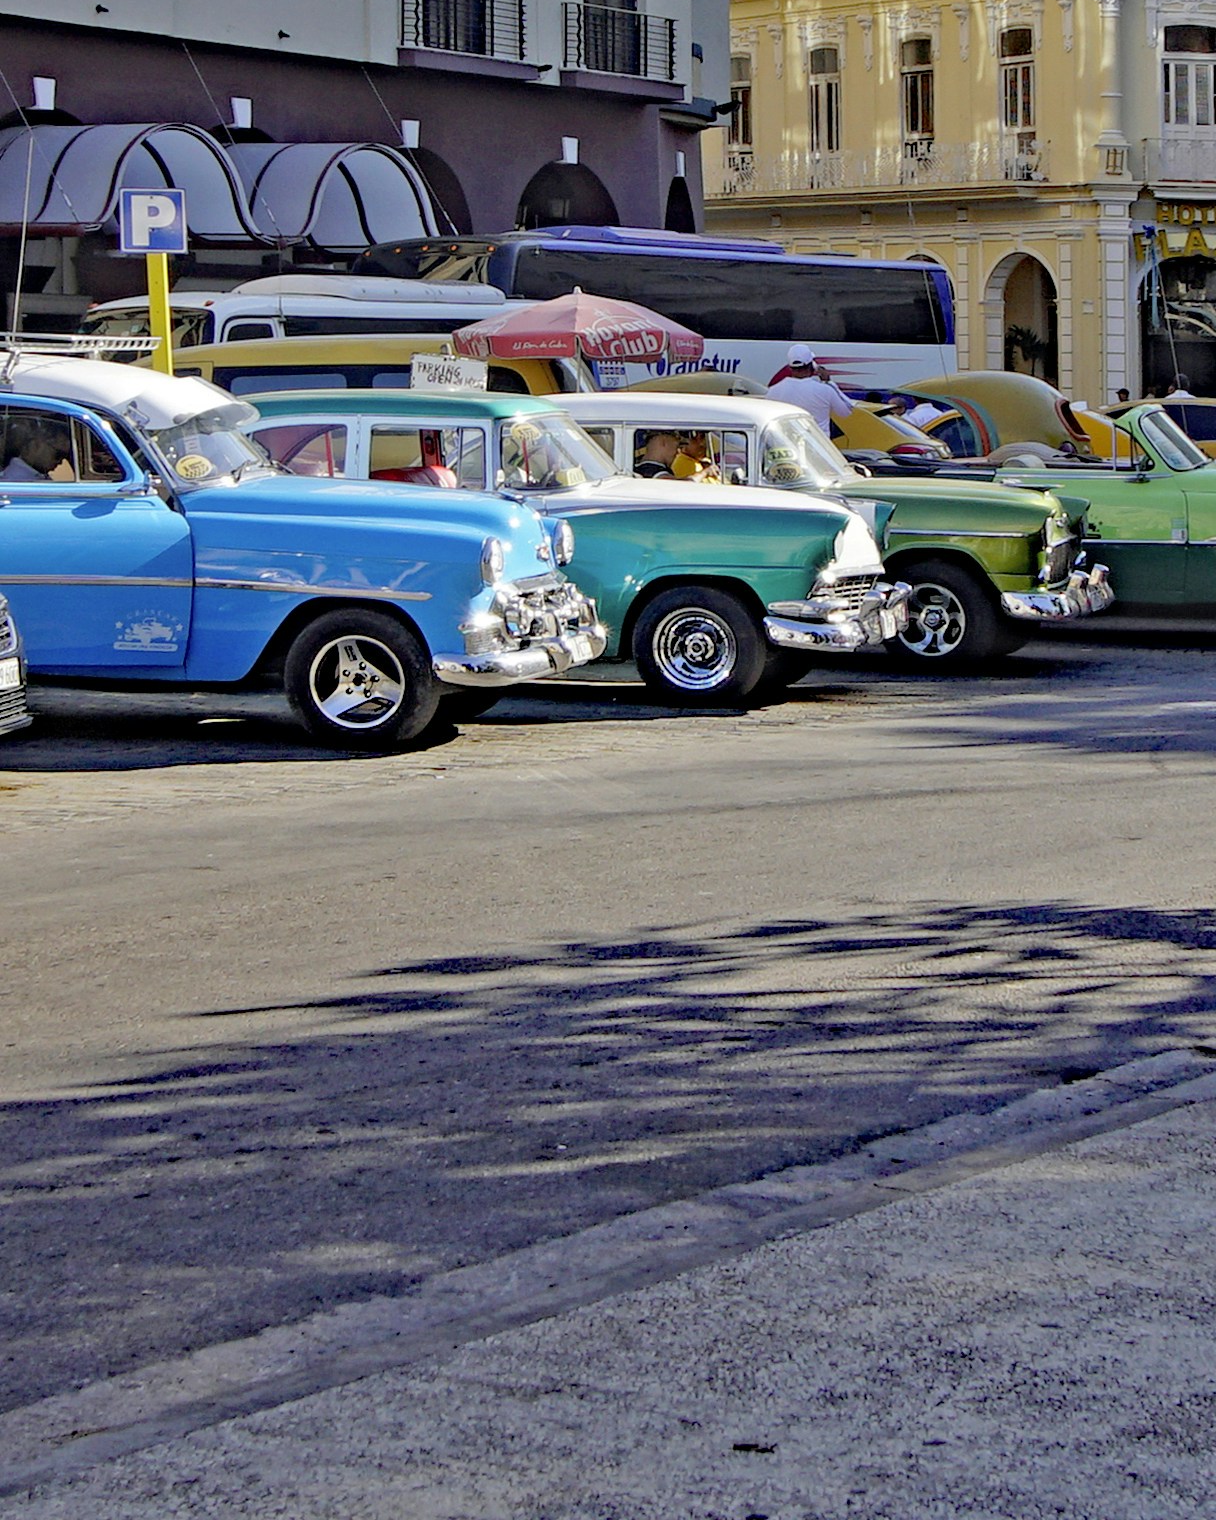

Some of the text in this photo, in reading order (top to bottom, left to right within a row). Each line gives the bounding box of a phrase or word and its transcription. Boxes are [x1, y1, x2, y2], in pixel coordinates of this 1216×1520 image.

[131, 194, 176, 246] P
[610, 331, 658, 356] Club
[418, 362, 462, 377] PARKING
[427, 373, 452, 384] OPEN
